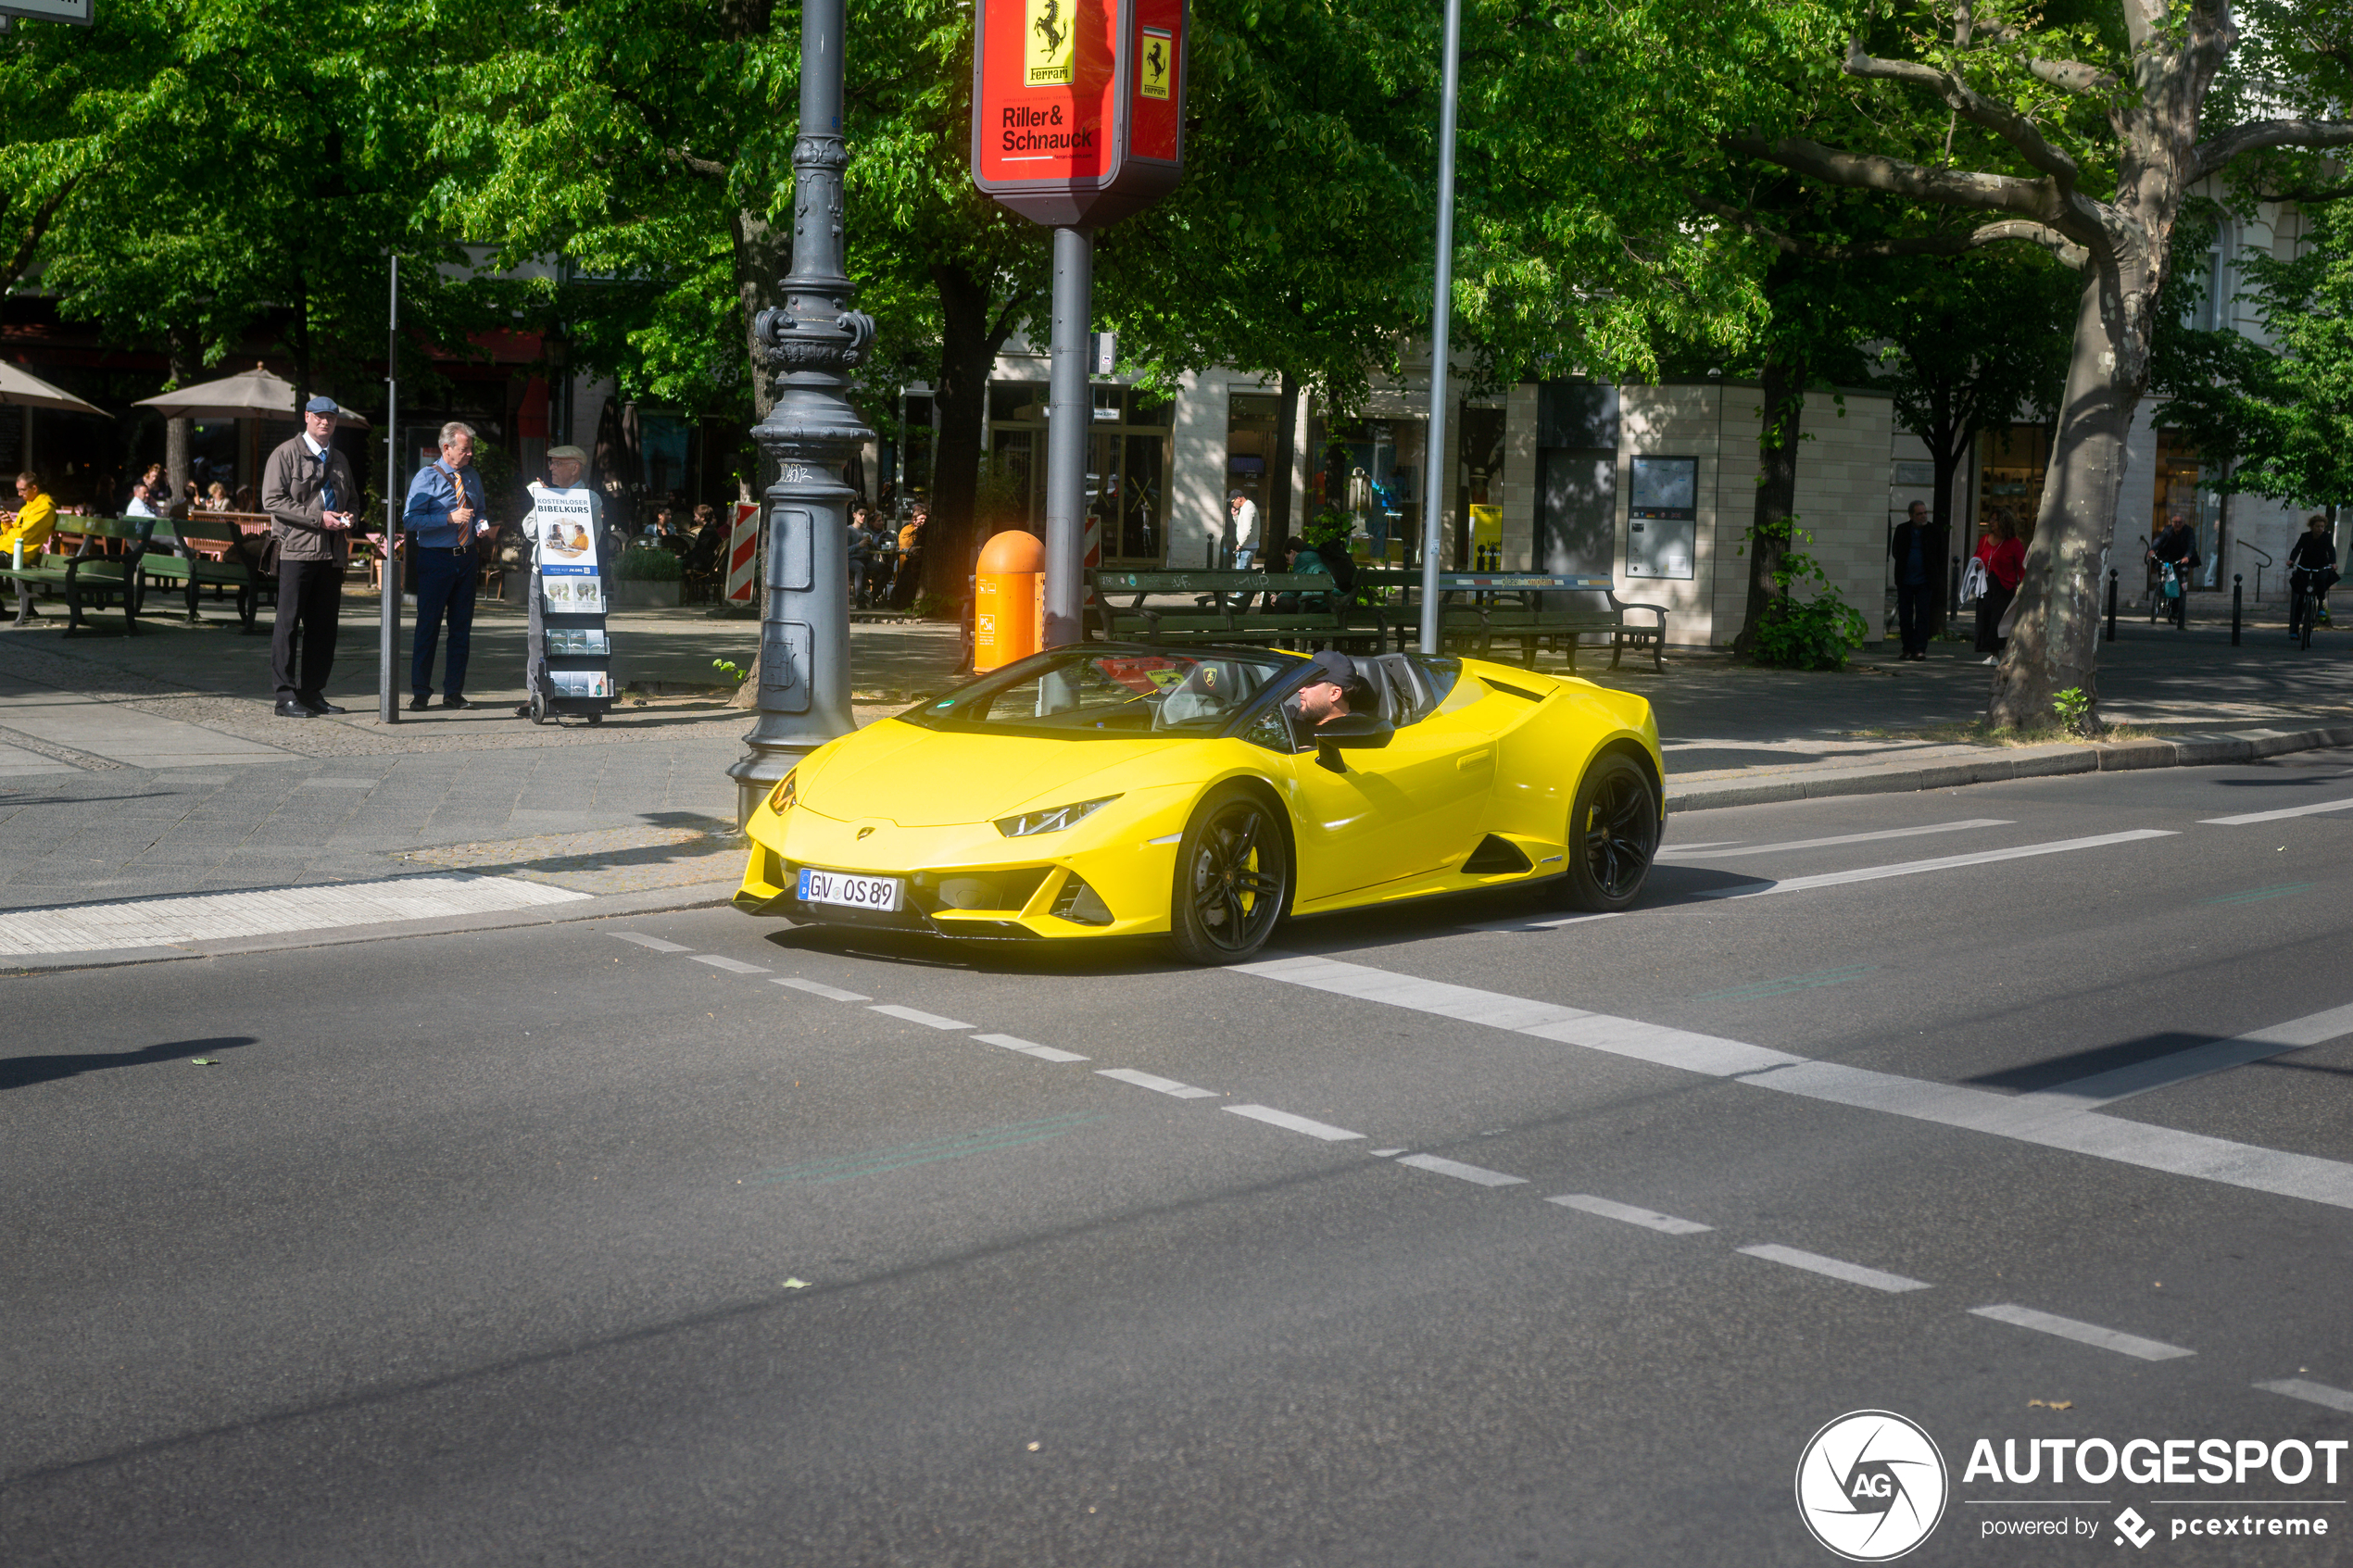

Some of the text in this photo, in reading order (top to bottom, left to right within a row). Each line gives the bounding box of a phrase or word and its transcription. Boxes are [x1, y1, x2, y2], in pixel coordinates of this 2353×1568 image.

[1030, 66, 1068, 81] Ferrari
[1144, 84, 1166, 96] Ferrari
[1002, 127, 1092, 151] Schnauck
[537, 506, 589, 514] BIBELKURS
[1502, 576, 1552, 588] please complain
[810, 874, 833, 898] GV
